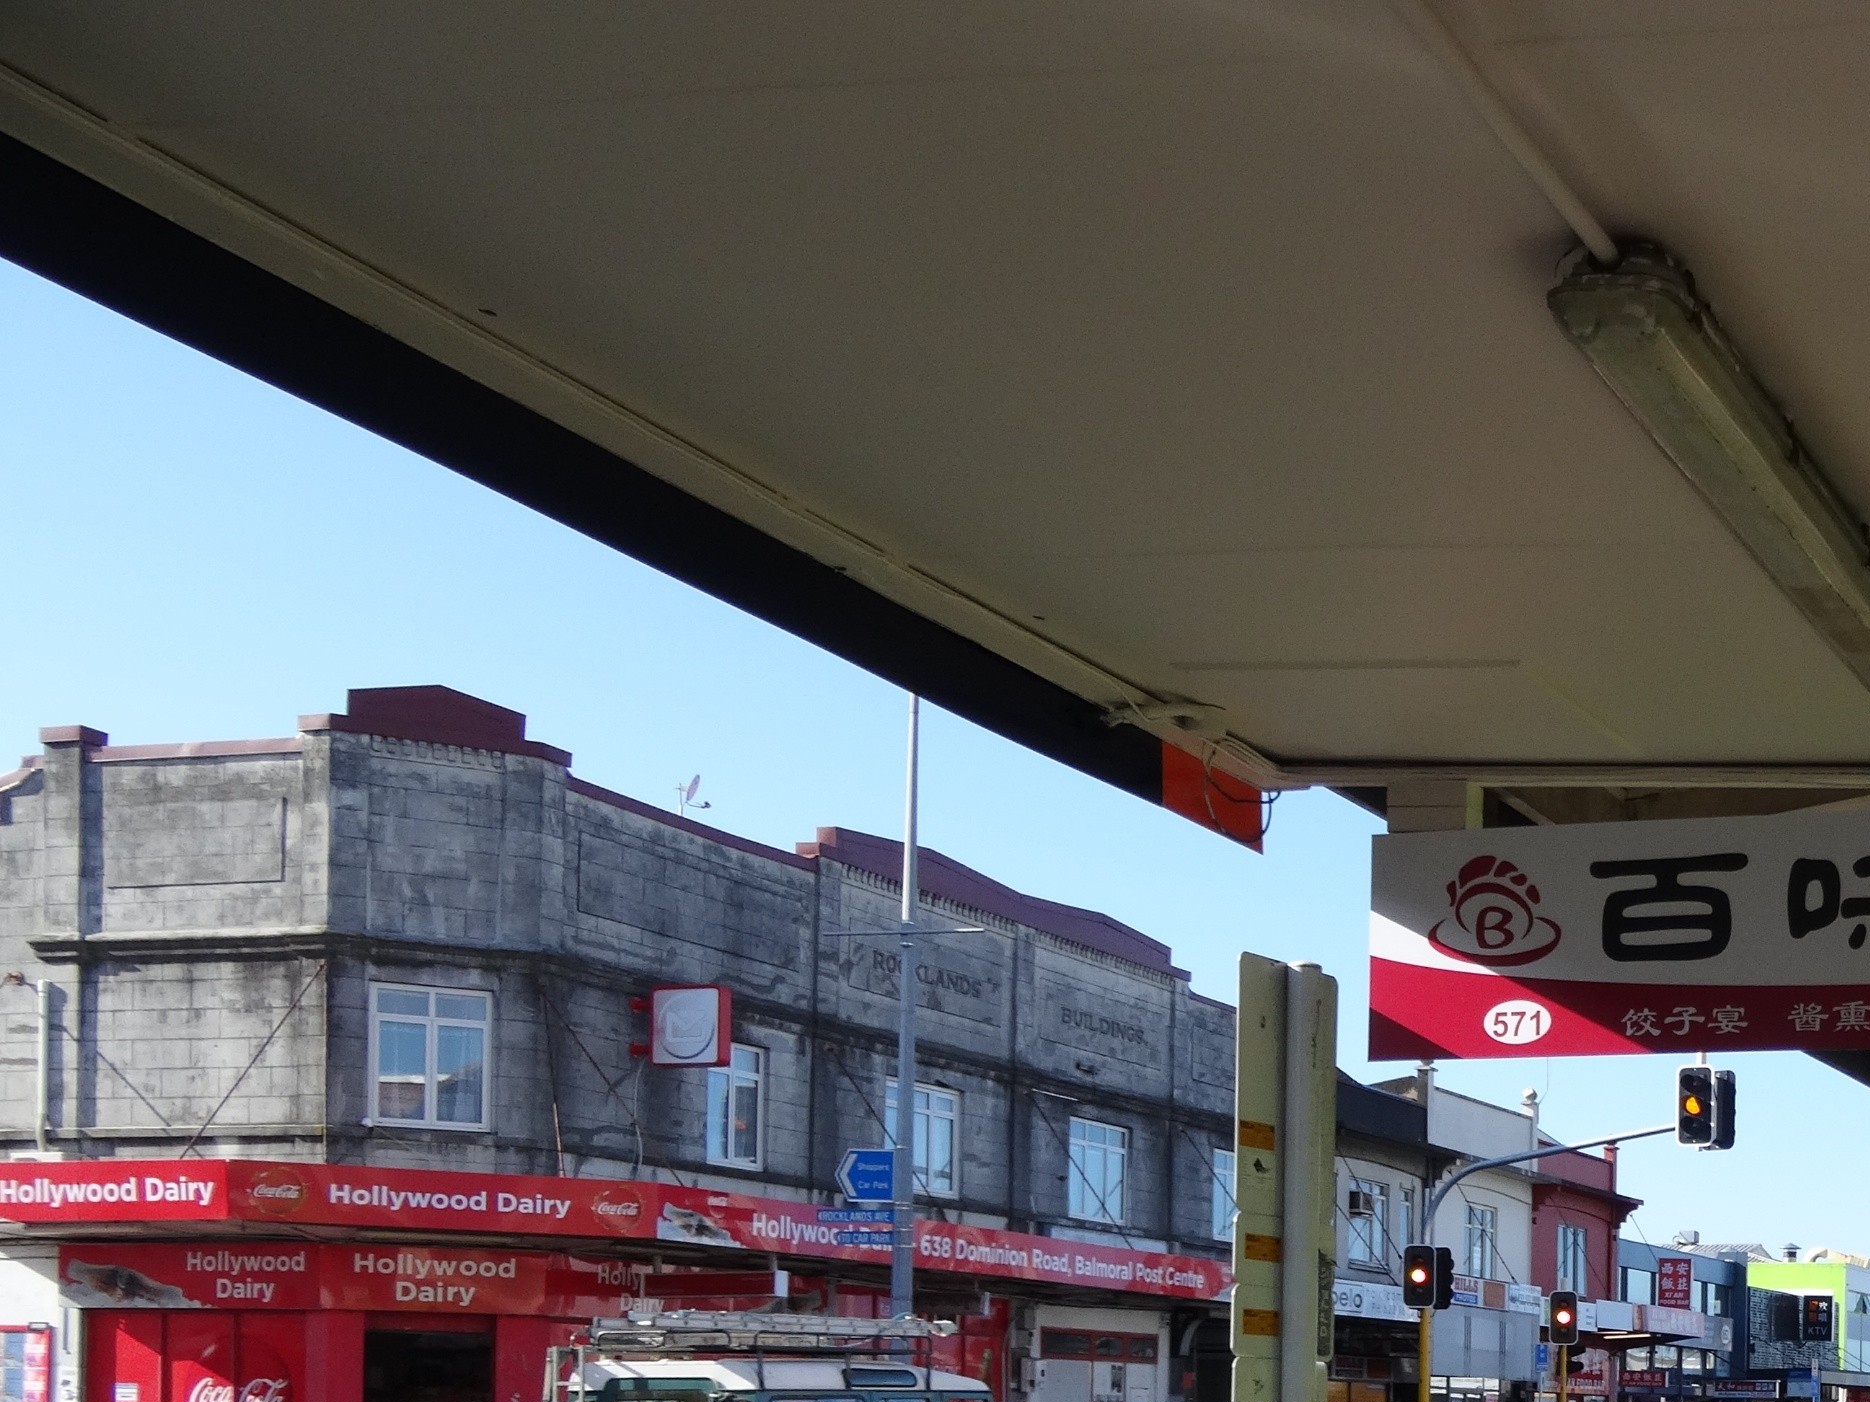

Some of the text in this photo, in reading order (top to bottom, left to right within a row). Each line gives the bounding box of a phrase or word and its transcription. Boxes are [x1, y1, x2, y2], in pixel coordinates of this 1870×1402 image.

[1491, 1010, 1544, 1038] 571
[1620, 1005, 1748, 1037] 饺子宴
[0, 1177, 214, 1208] Hollywood Dairy
[330, 1184, 571, 1219] Hollywood Dairy
[187, 1251, 305, 1275] Hollywood
[354, 1253, 516, 1279] Hollywood
[920, 1234, 951, 1259] 638
[955, 1239, 1026, 1268] Dominion
[1032, 1249, 1072, 1277] Road,
[1075, 1255, 1133, 1281] Balmoral
[1135, 1262, 1165, 1285] Post
[1166, 1266, 1205, 1289] Centre
[216, 1278, 274, 1302] Dairy
[395, 1281, 475, 1306] Dairy
[1808, 1327, 1828, 1335] KTV
